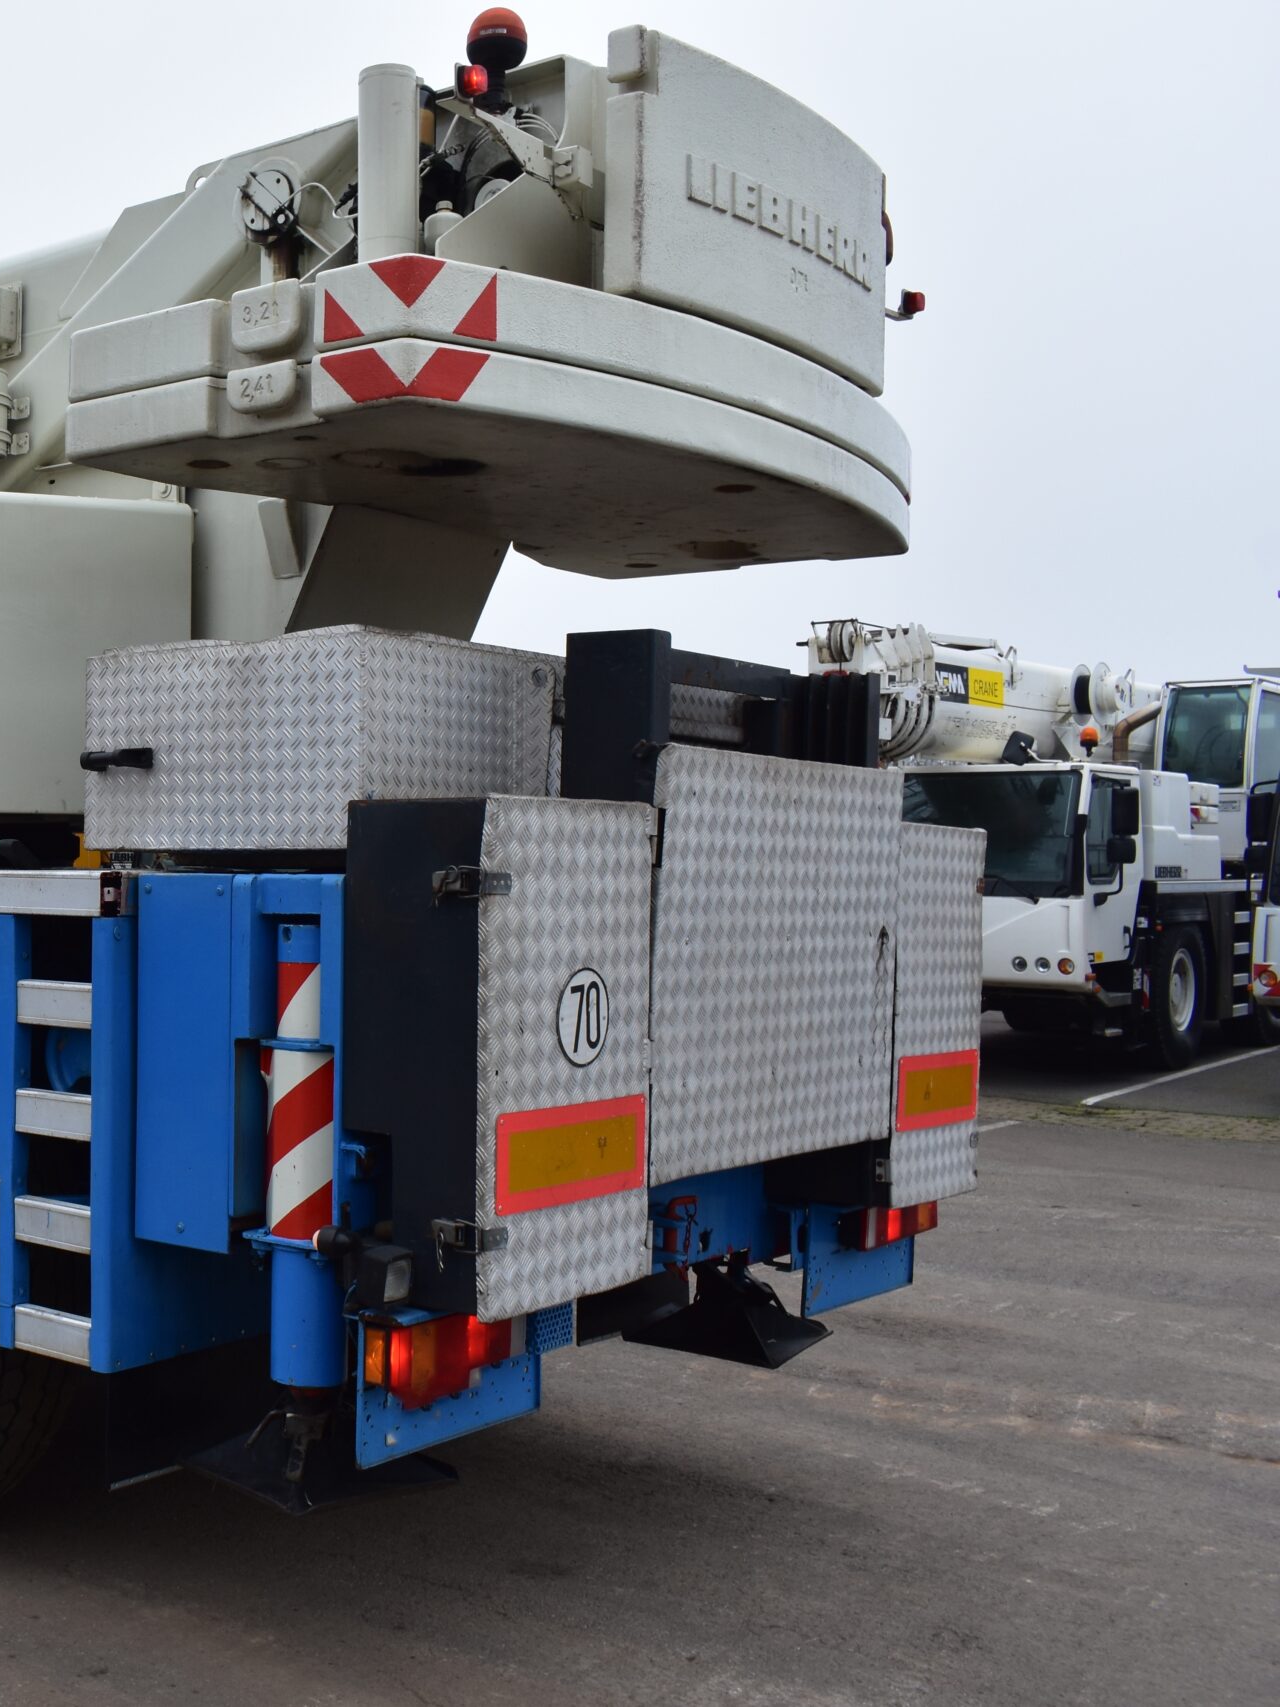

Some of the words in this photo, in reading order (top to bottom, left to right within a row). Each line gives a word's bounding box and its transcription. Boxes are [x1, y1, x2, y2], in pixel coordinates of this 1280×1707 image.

[686, 153, 872, 293] LIEBHERR
[973, 679, 999, 698] CRANE
[1154, 865, 1182, 879] LIEBHERR
[570, 980, 601, 1054] 70
